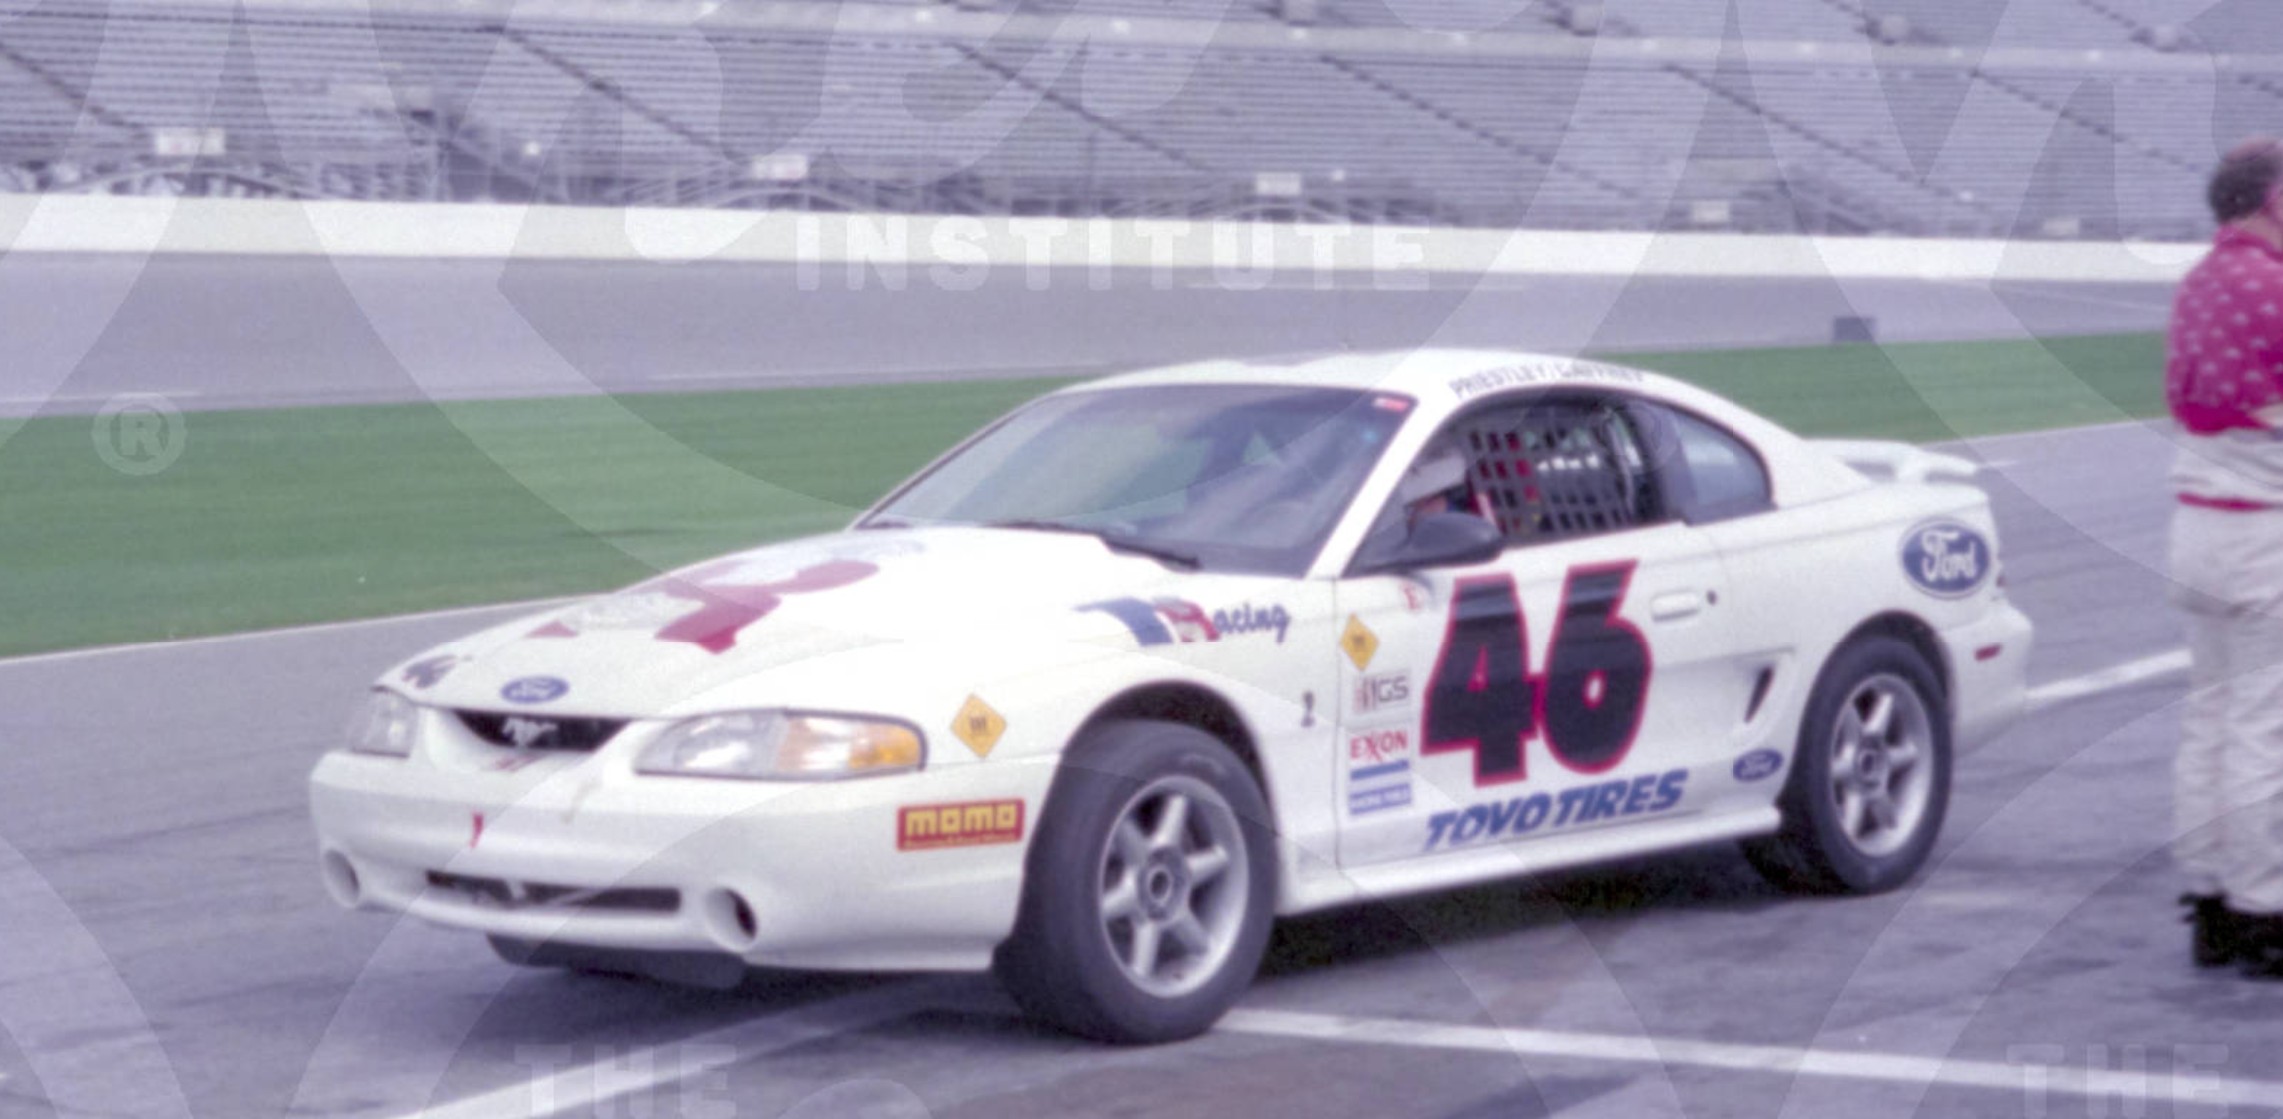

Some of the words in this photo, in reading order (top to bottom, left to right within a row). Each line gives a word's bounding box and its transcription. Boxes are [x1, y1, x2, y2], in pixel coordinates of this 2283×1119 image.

[1920, 530, 1977, 582] Ford
[1420, 558, 1654, 789] 46
[1350, 730, 1409, 763] EXXON
[1552, 768, 1690, 827] TIRES
